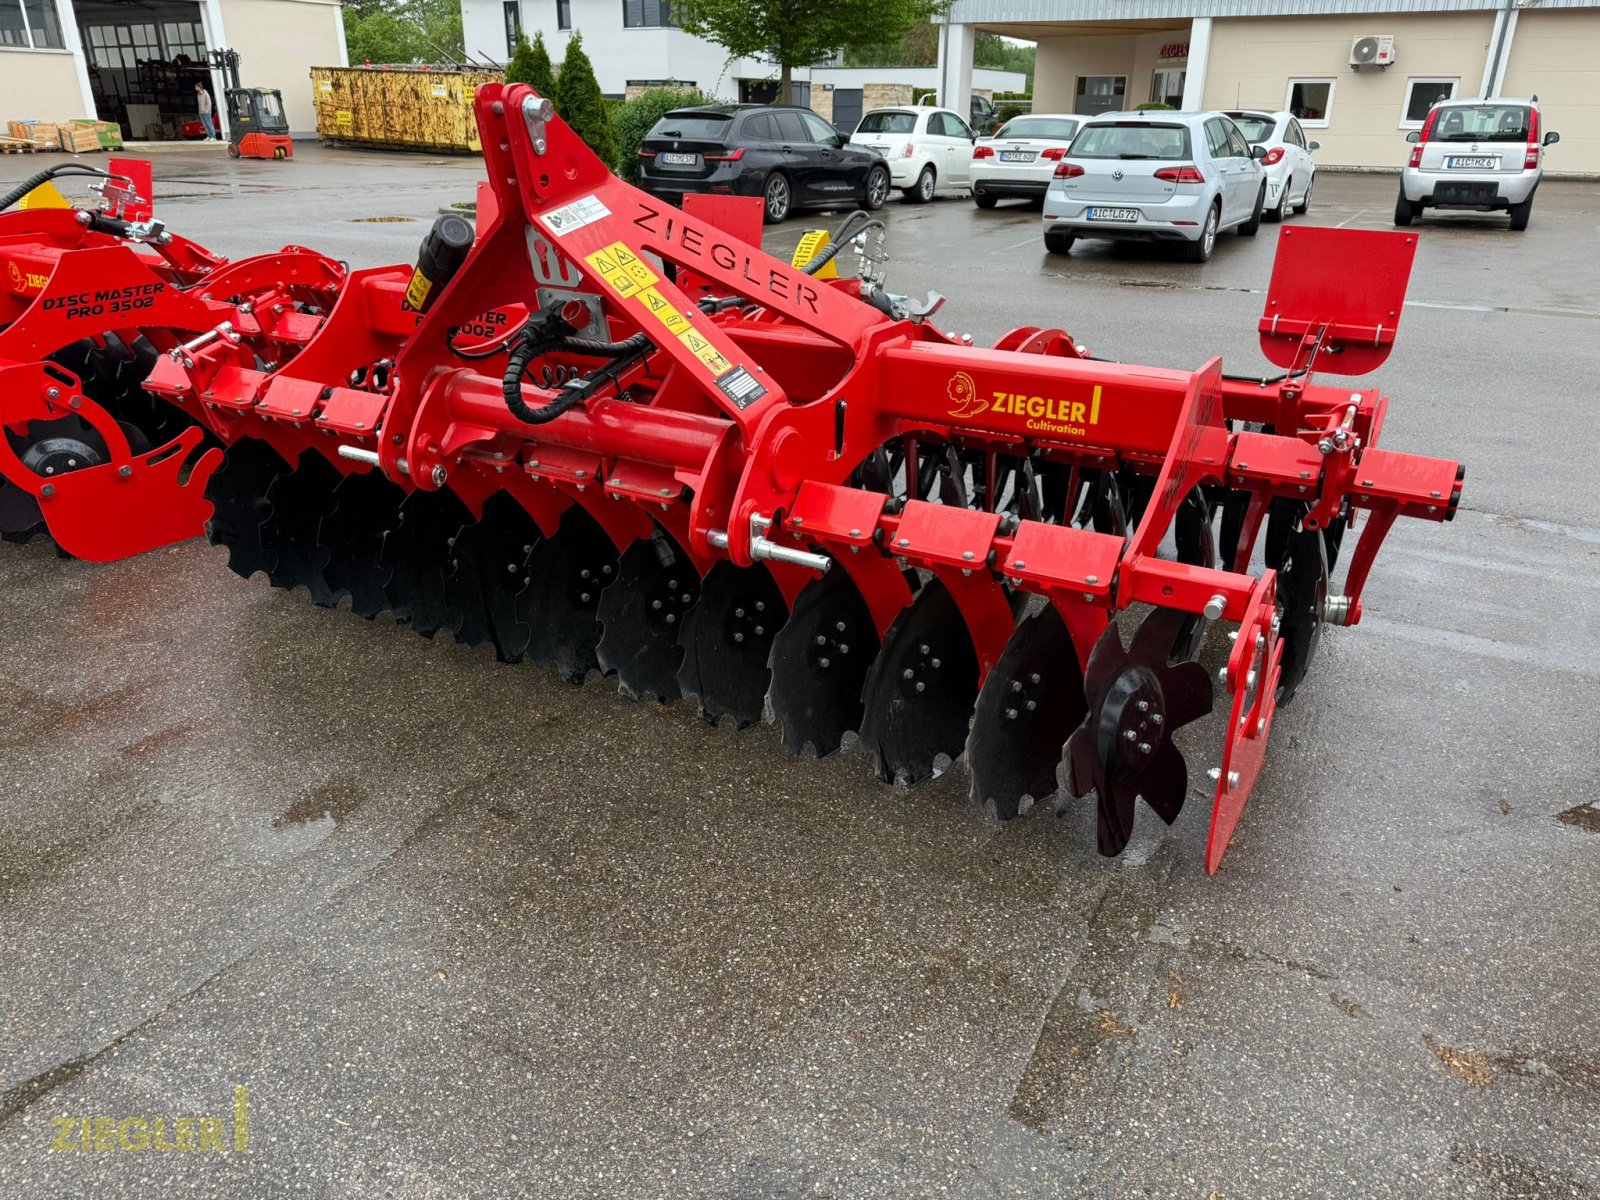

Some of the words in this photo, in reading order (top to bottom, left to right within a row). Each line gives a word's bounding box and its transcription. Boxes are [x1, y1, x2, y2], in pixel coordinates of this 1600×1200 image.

[633, 203, 818, 314] ZIEGLER
[26, 273, 50, 288] ZIEG
[43, 293, 90, 311] DISC
[95, 283, 165, 303] MASTER
[67, 304, 104, 320] PRO
[109, 298, 154, 314] 3502
[991, 391, 1086, 423] ZIEGLER
[1026, 419, 1085, 436] Cultivation
